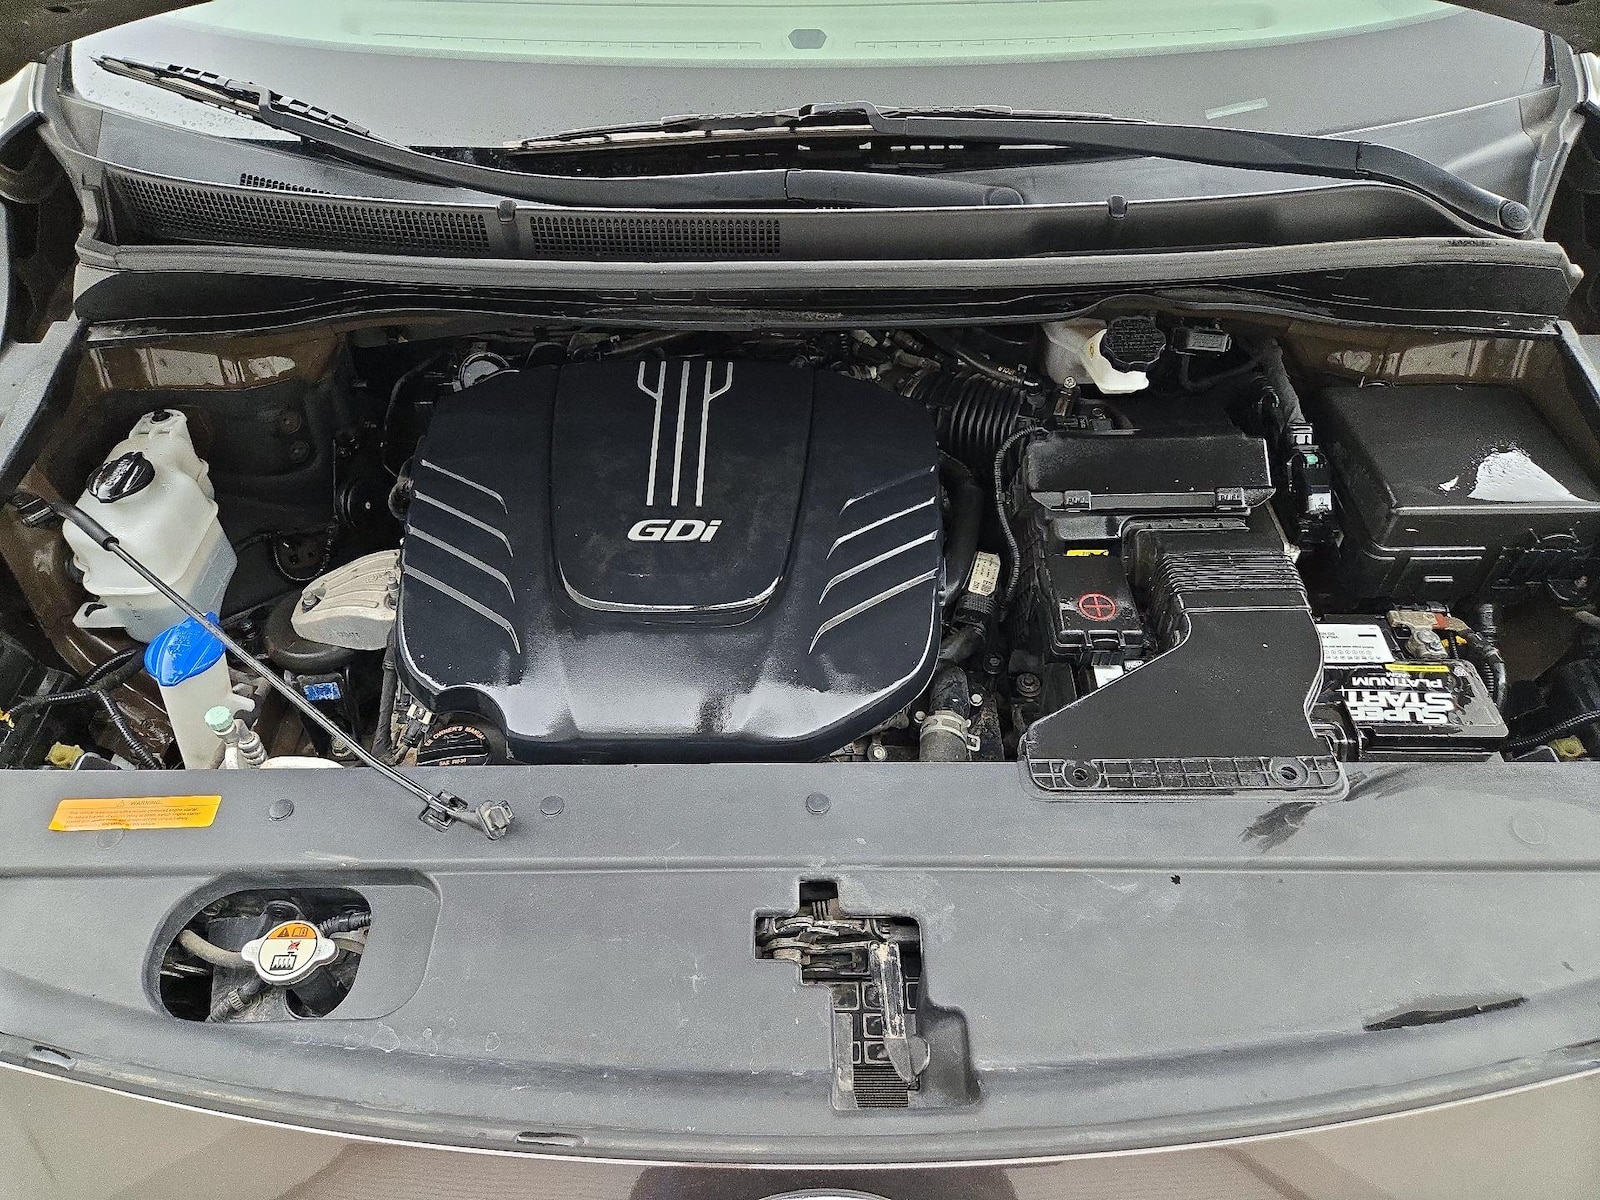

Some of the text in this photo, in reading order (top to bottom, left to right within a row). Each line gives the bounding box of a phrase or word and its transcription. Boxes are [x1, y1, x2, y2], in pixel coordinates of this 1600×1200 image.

[627, 519, 723, 542] GDi
[1352, 676, 1444, 689] PLATINUM
[1345, 691, 1455, 712] START
[433, 725, 463, 740] OWNER'S
